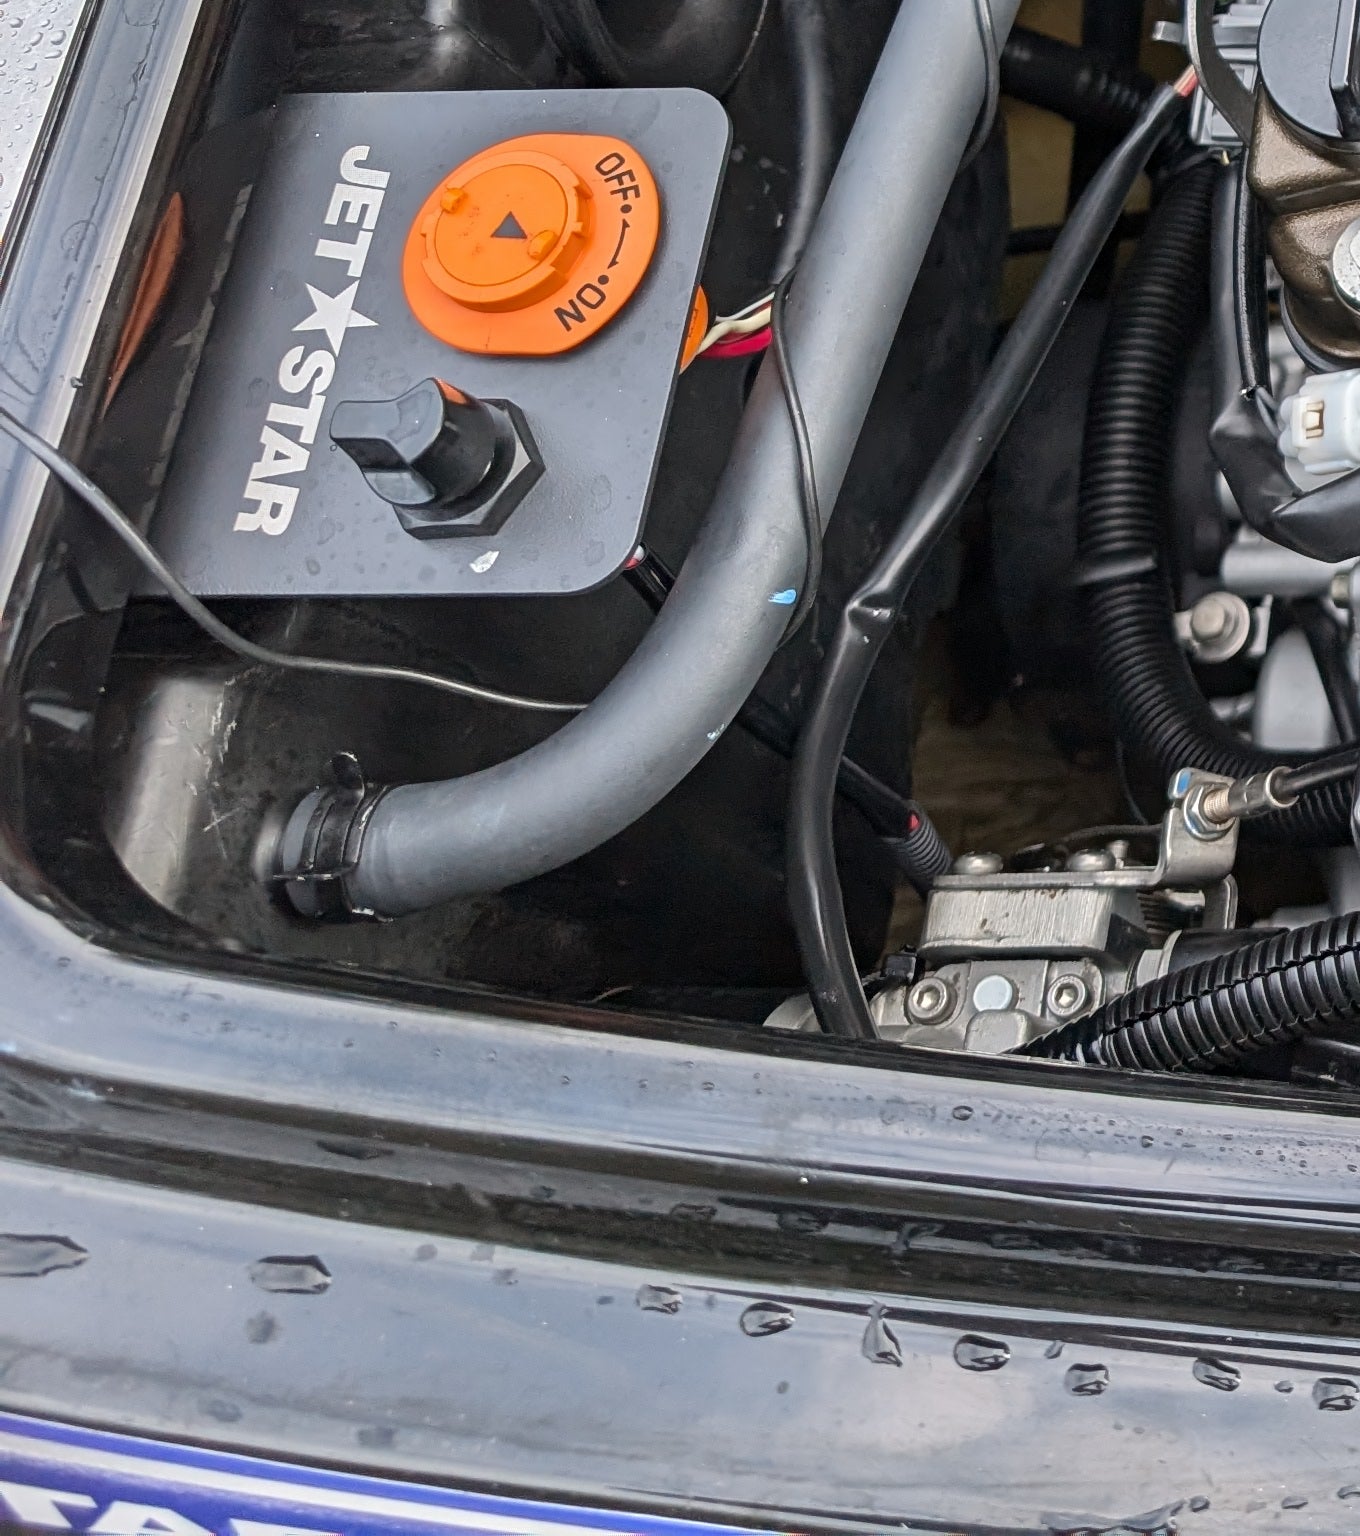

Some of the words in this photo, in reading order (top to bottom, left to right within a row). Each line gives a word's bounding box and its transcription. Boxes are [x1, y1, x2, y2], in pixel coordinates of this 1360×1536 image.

[315, 145, 391, 278] JET
[595, 152, 640, 201] OFF
[554, 283, 606, 332] ON
[233, 345, 336, 536] STAR
